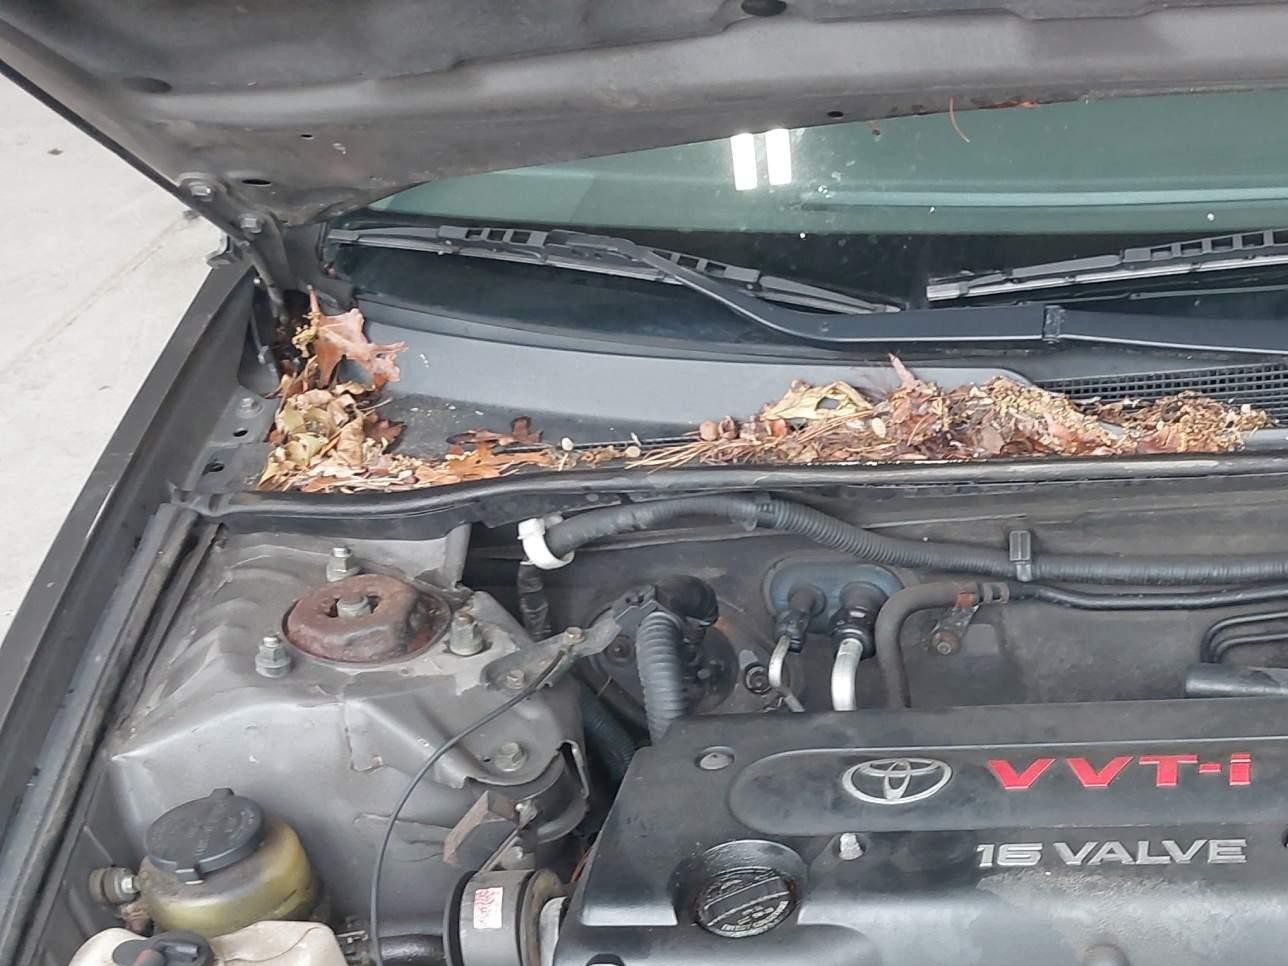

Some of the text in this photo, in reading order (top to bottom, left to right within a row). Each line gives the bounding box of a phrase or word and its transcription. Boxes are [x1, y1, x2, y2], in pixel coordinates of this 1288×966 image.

[987, 753, 1251, 790] VVT-i
[977, 839, 1247, 868] 16 VALVE
